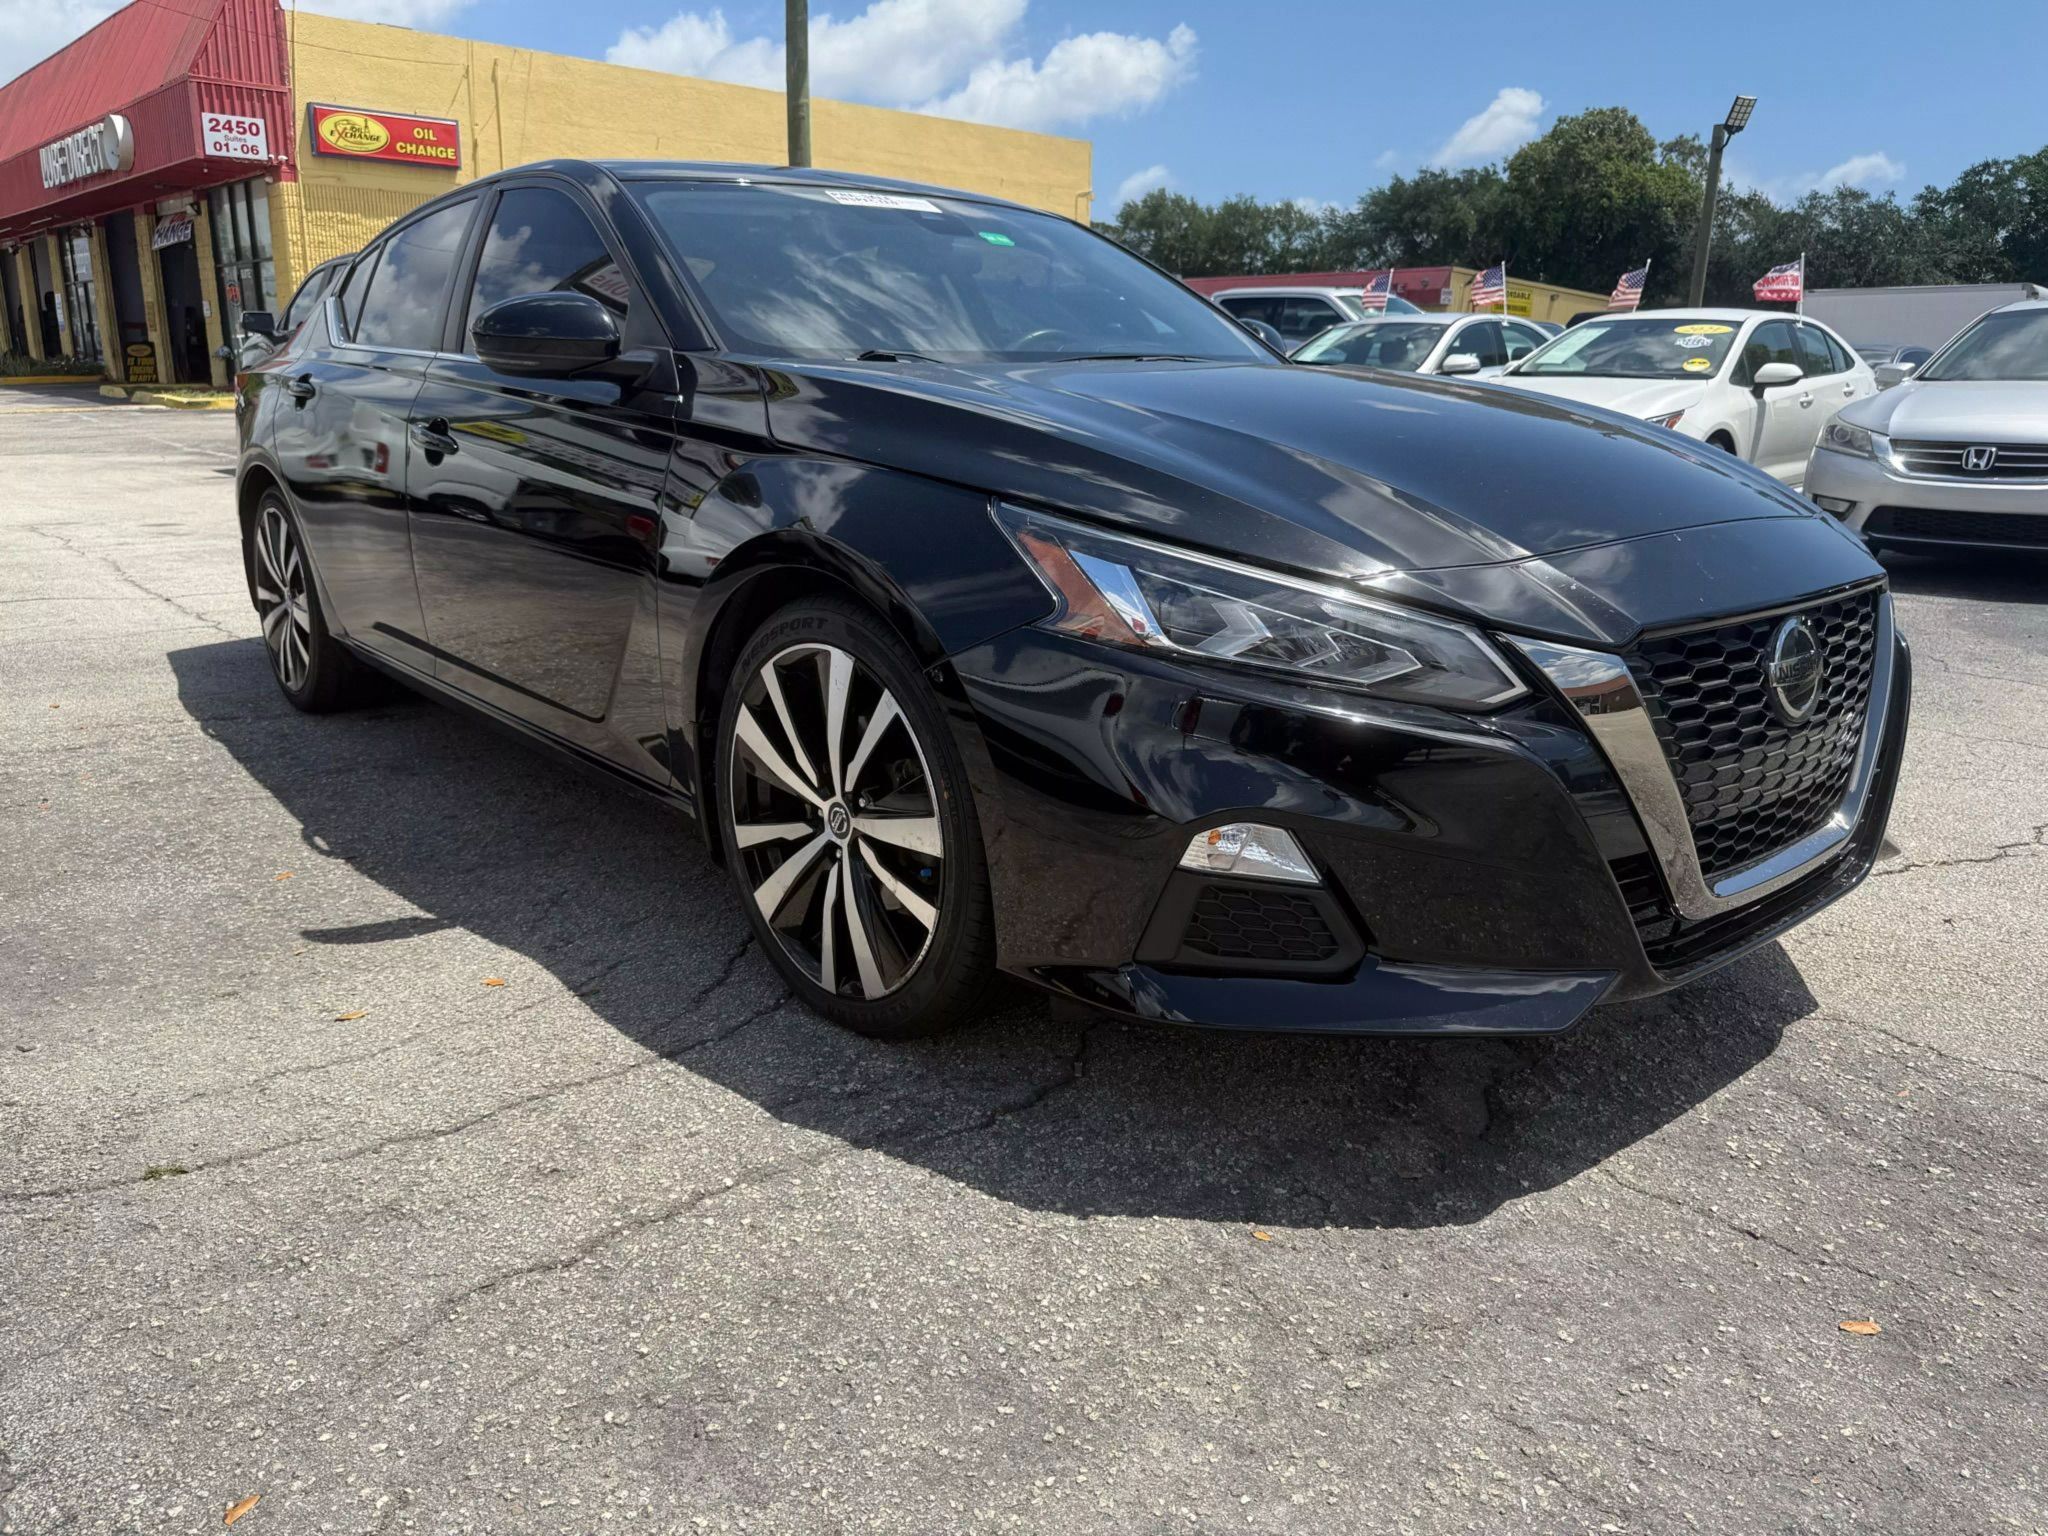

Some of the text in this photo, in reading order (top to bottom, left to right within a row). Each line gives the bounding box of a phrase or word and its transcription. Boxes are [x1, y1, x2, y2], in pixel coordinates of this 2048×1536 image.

[208, 117, 260, 137] 2450
[413, 127, 437, 141] OIL
[223, 134, 247, 143] Suites
[40, 122, 104, 189] LUBE DIRECT
[396, 142, 456, 159] CHANGE
